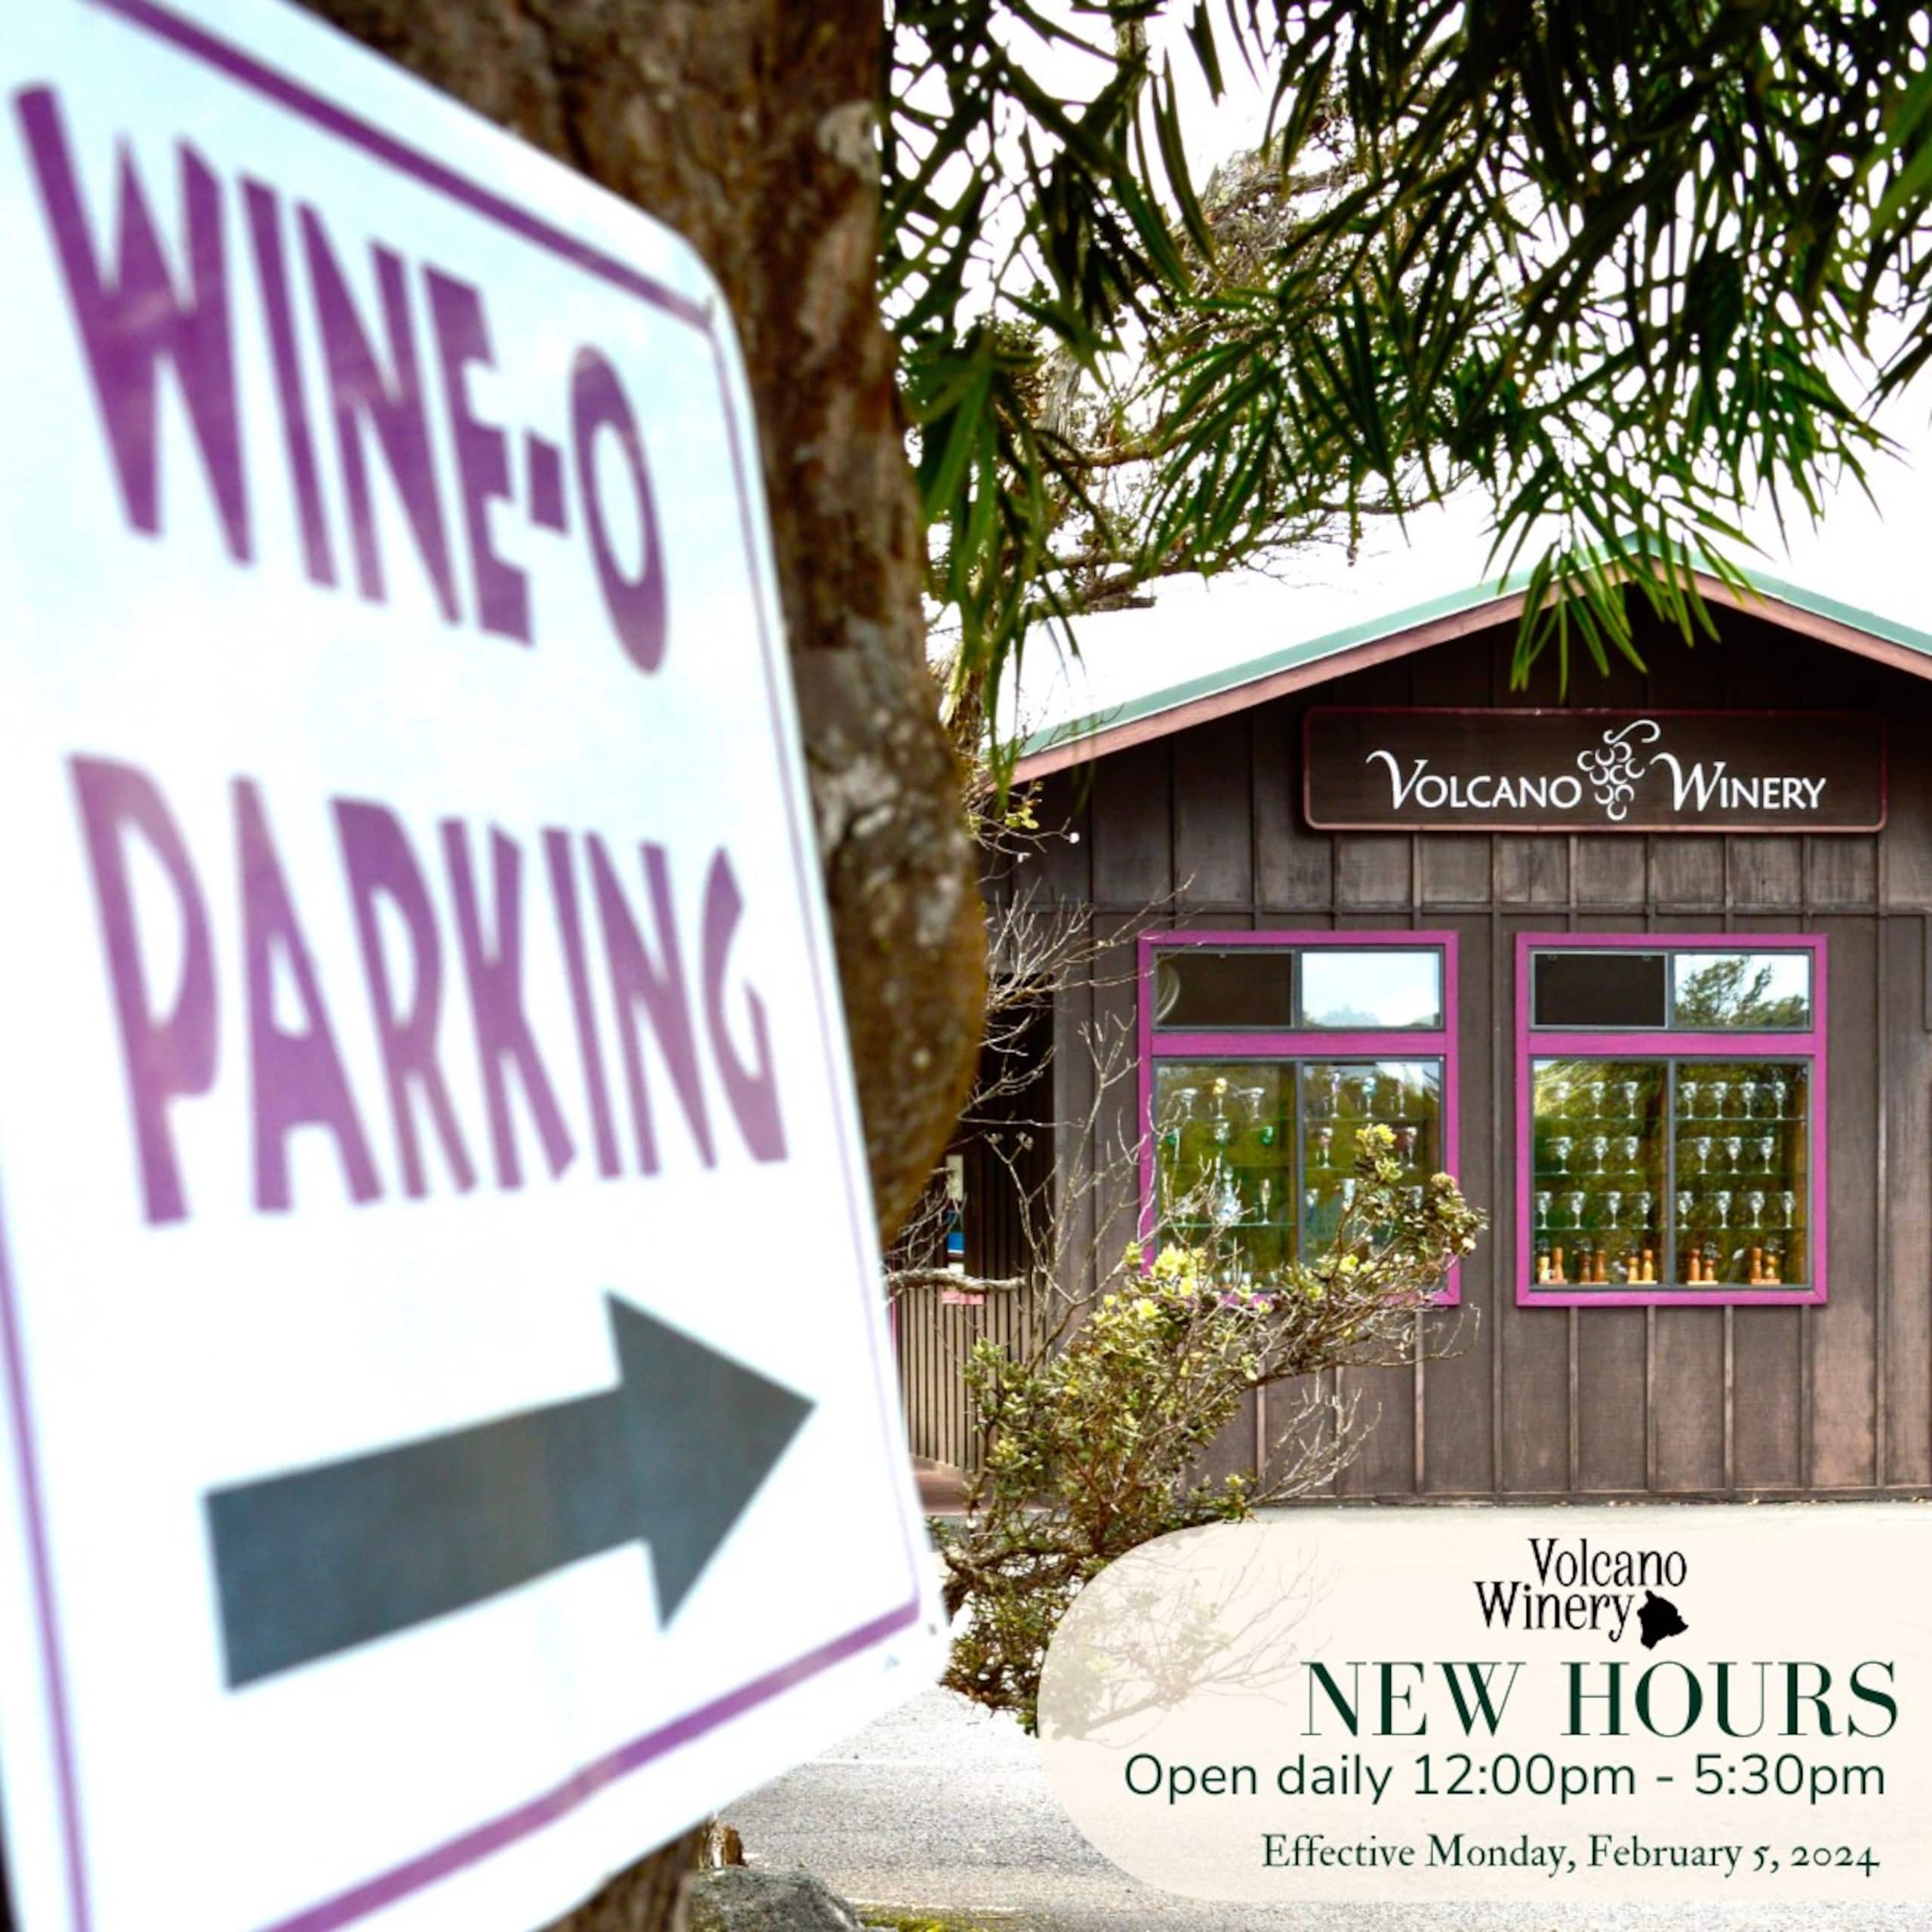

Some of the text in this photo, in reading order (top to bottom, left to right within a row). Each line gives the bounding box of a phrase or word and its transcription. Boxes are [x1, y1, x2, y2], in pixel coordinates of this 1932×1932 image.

[13, 83, 669, 675] WINE-O
[68, 752, 788, 1226] PARKING
[1365, 749, 1826, 812] VOLCANO WINERY
